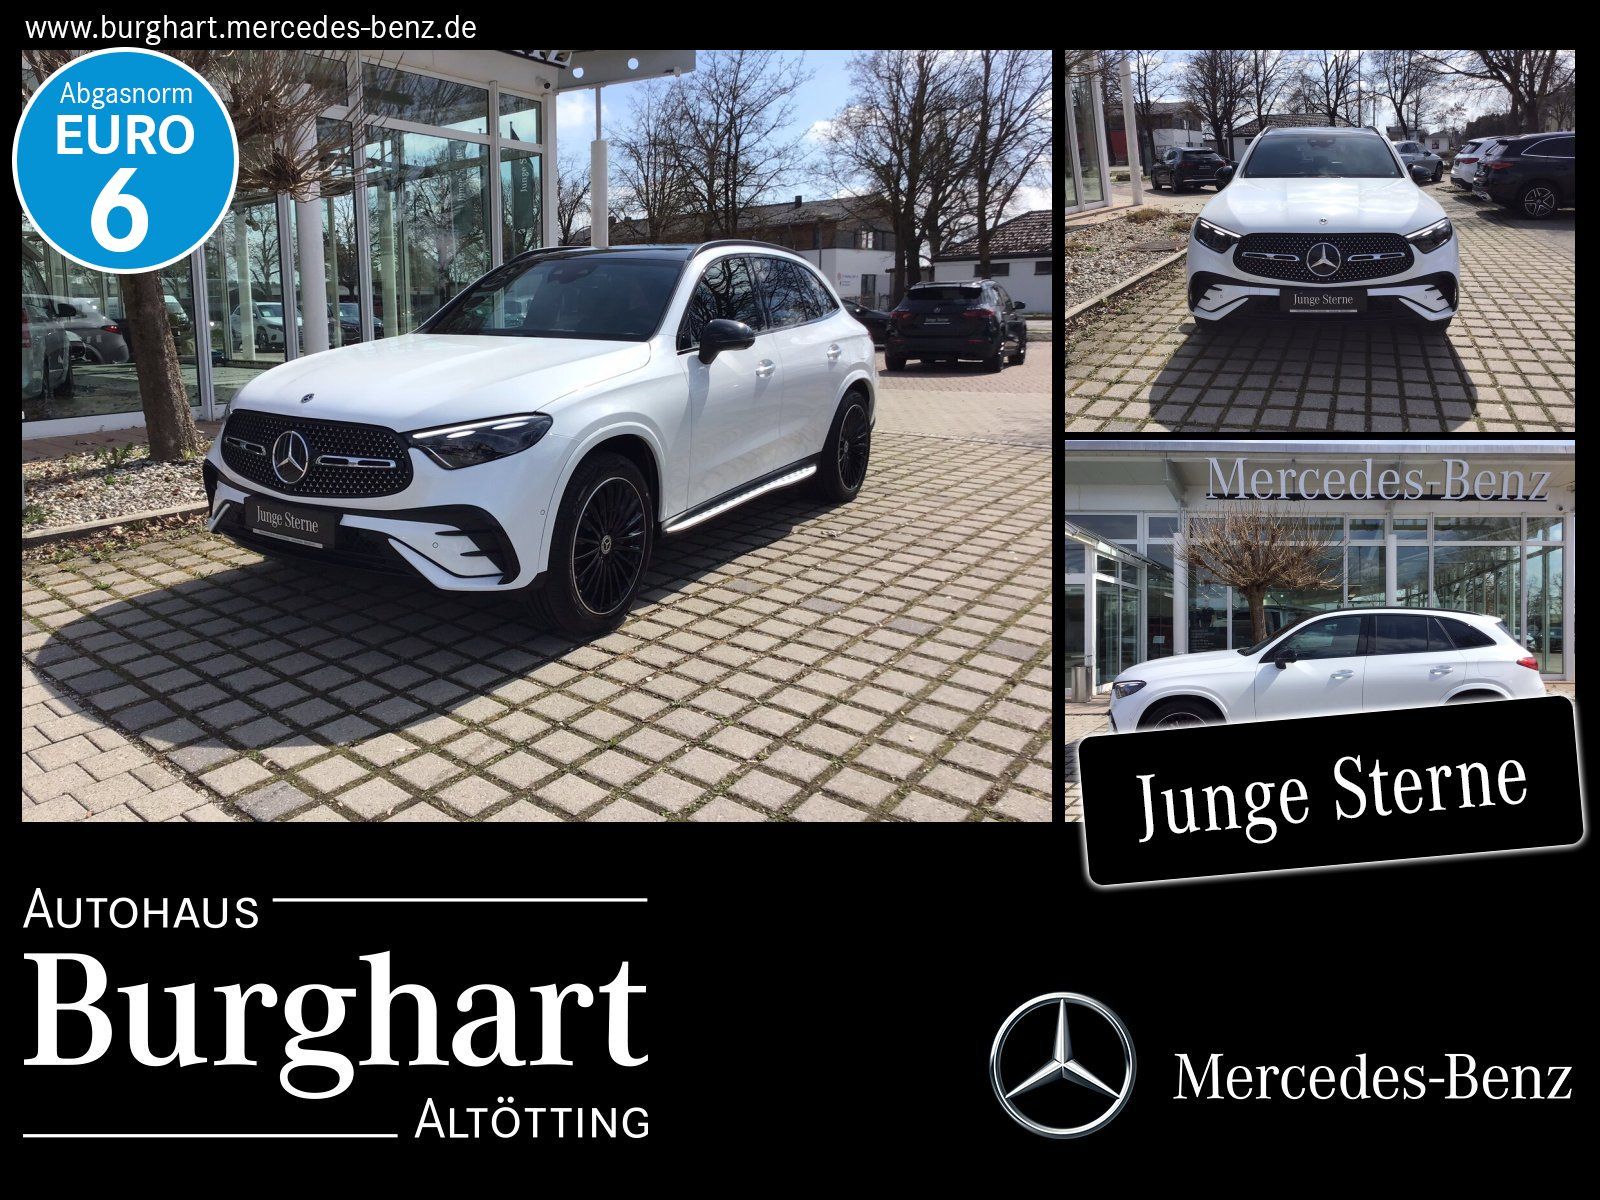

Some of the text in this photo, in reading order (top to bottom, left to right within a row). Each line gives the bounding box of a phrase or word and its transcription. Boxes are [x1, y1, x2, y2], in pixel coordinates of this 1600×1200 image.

[1293, 293, 1354, 307] Junge Sterne
[1205, 457, 1552, 501] Mercedes-Benz
[256, 505, 319, 533] Junge Sterne
